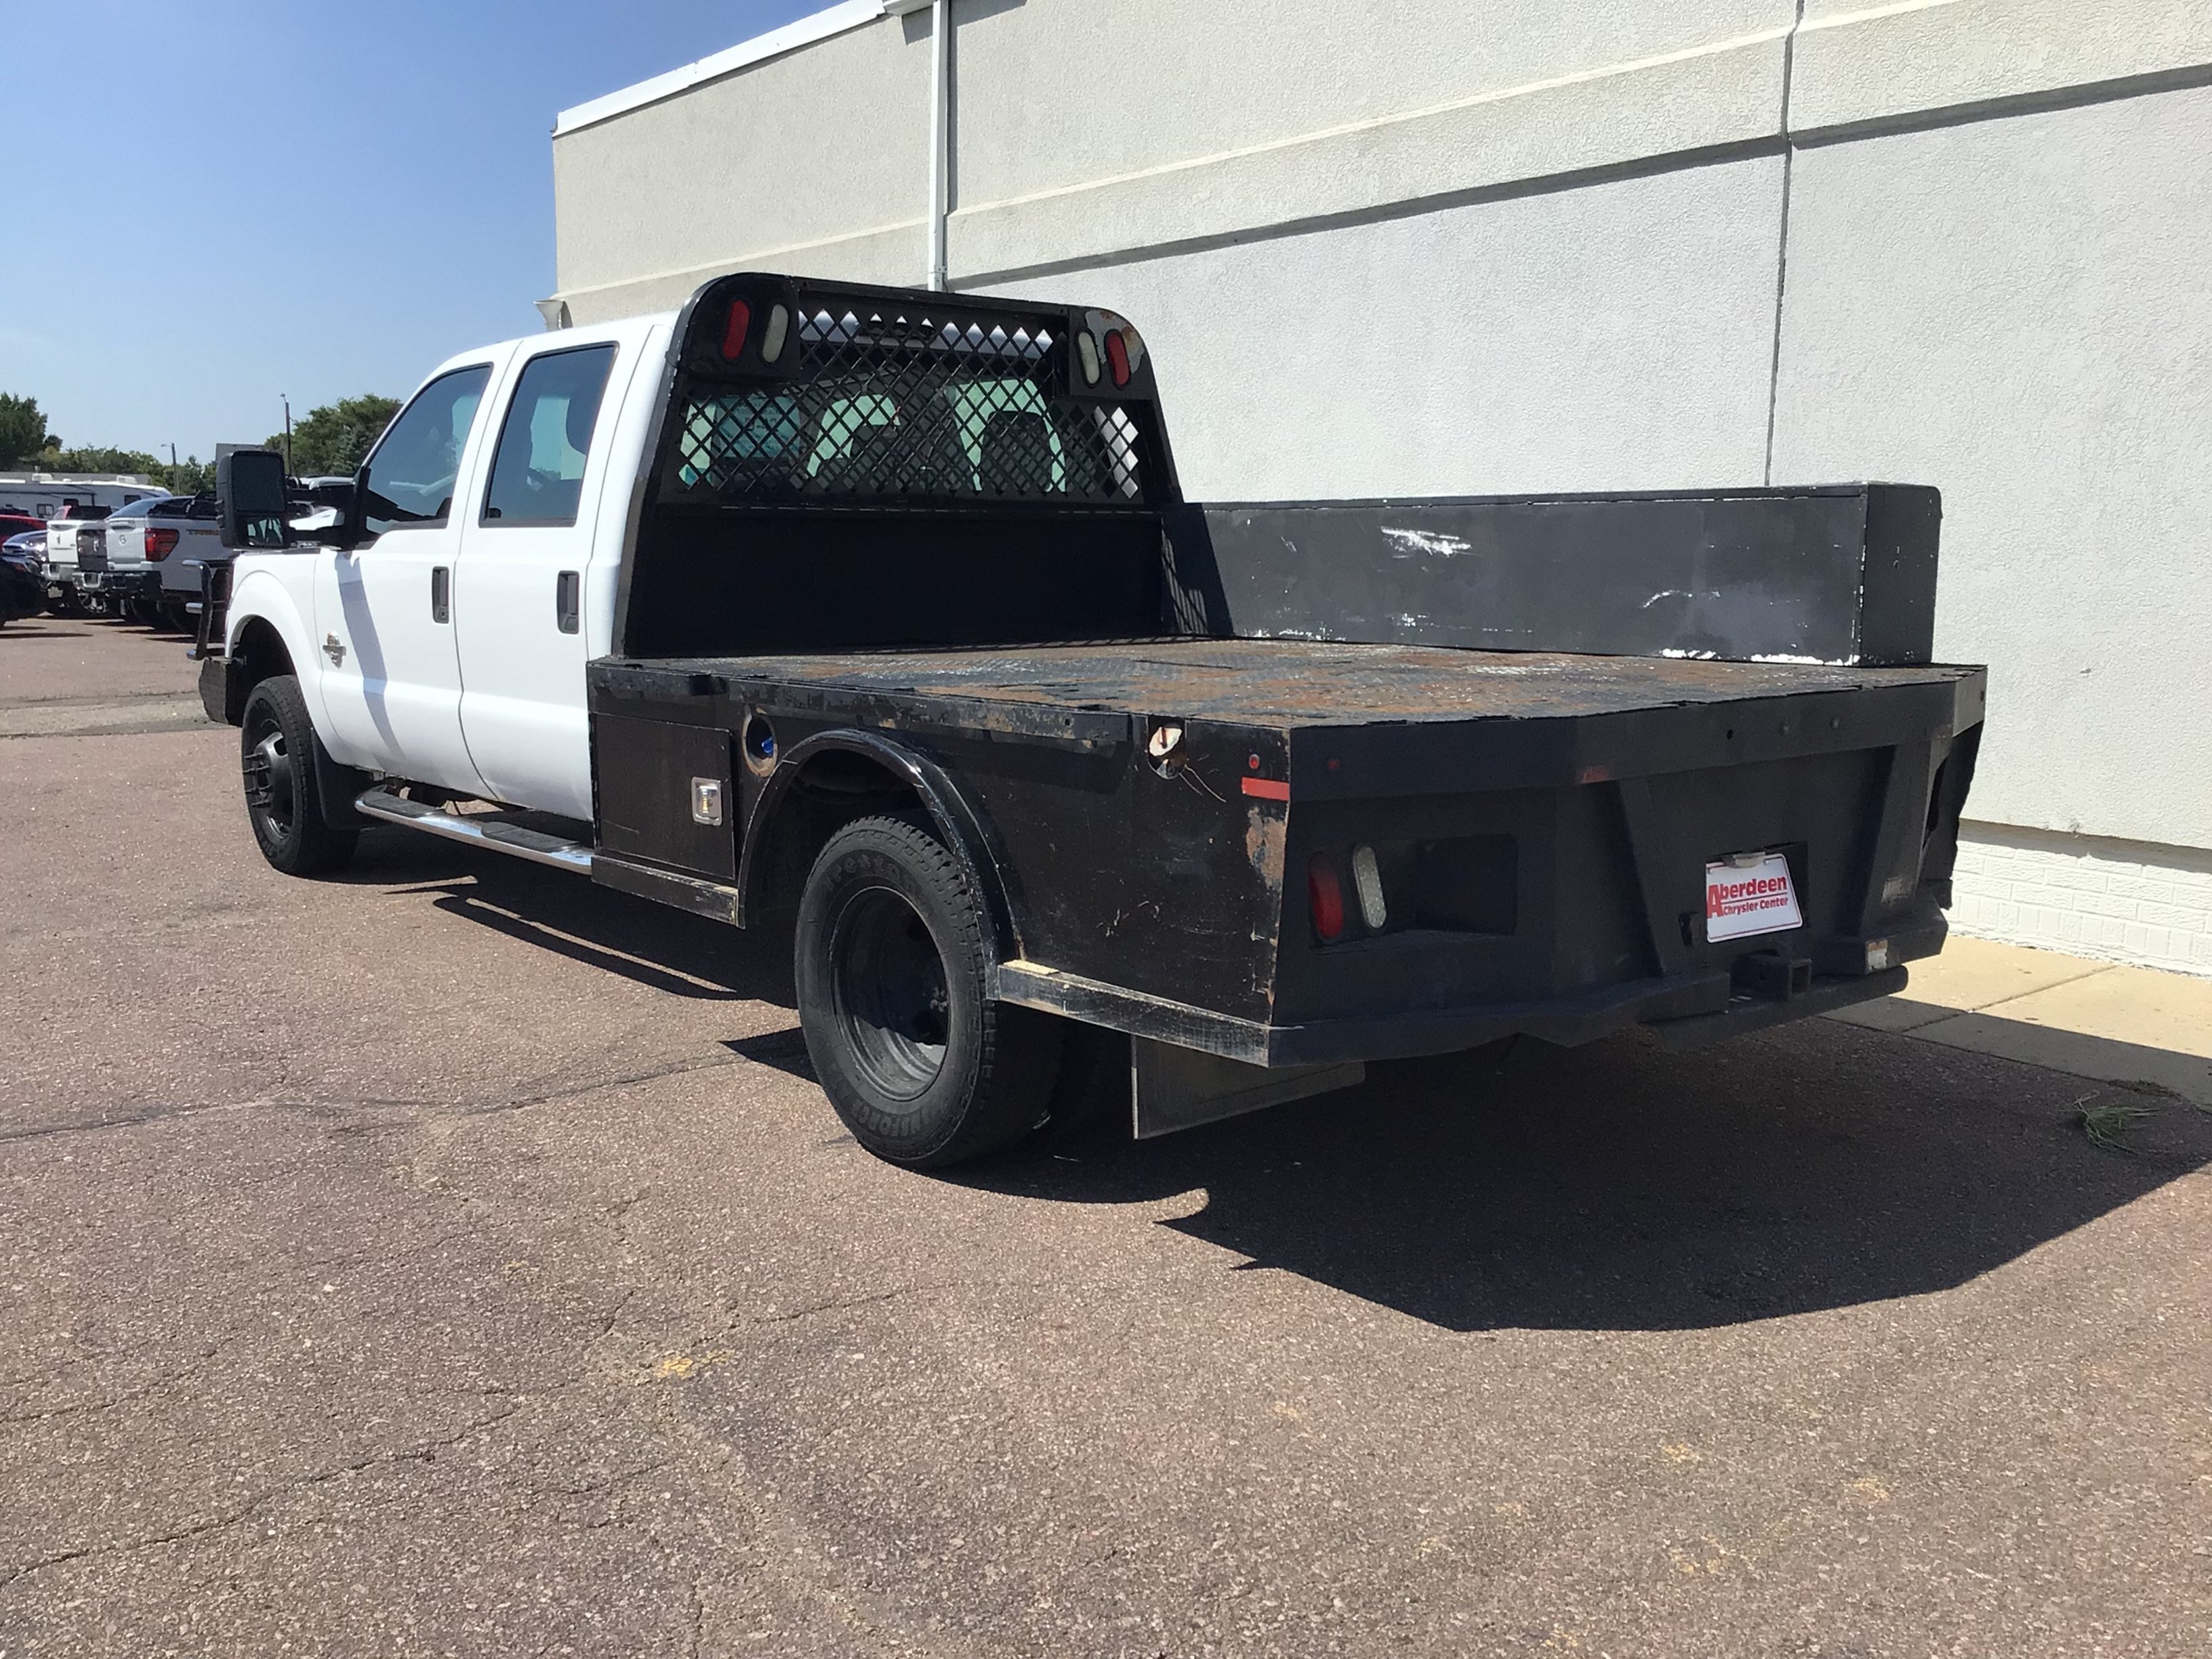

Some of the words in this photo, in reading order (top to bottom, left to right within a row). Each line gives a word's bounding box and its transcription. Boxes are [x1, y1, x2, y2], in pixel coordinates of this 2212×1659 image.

[1706, 876, 1787, 919] Aberdeen
[1723, 901, 1759, 915] Chrysler
[1760, 897, 1788, 909] Center
